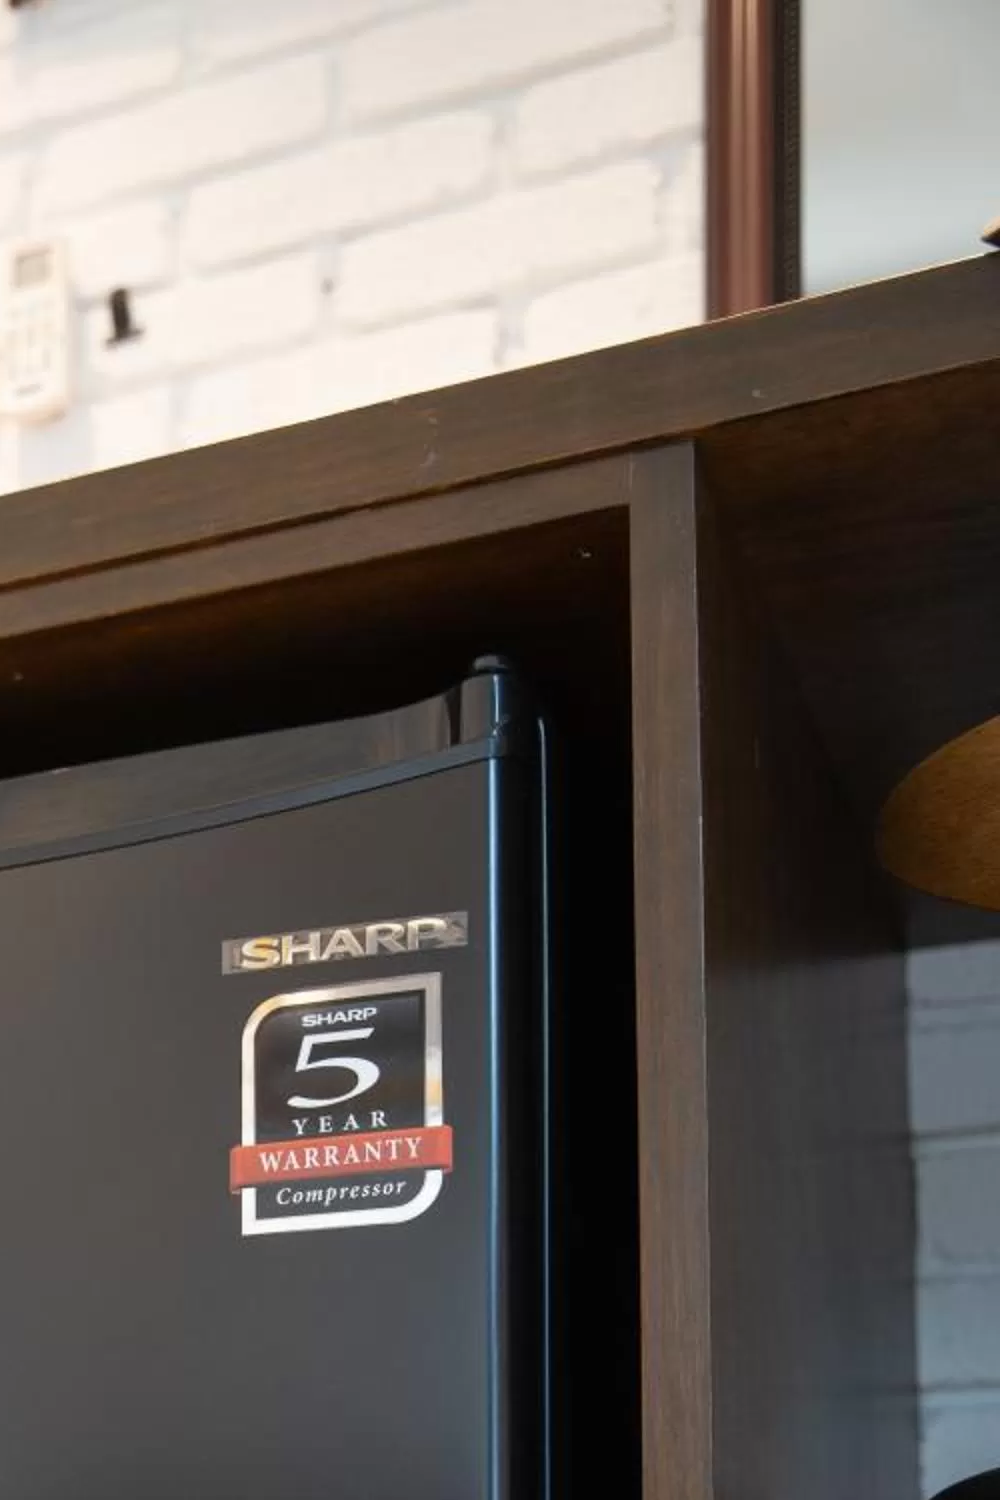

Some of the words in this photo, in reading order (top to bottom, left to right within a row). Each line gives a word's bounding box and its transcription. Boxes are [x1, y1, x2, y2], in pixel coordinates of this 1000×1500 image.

[241, 917, 450, 970] SHARP
[301, 1006, 378, 1028] SHARP
[287, 1027, 381, 1109] 5
[292, 1110, 388, 1136] YEAR
[259, 1136, 423, 1174] WARRANTY
[276, 1179, 407, 1206] Compressor
